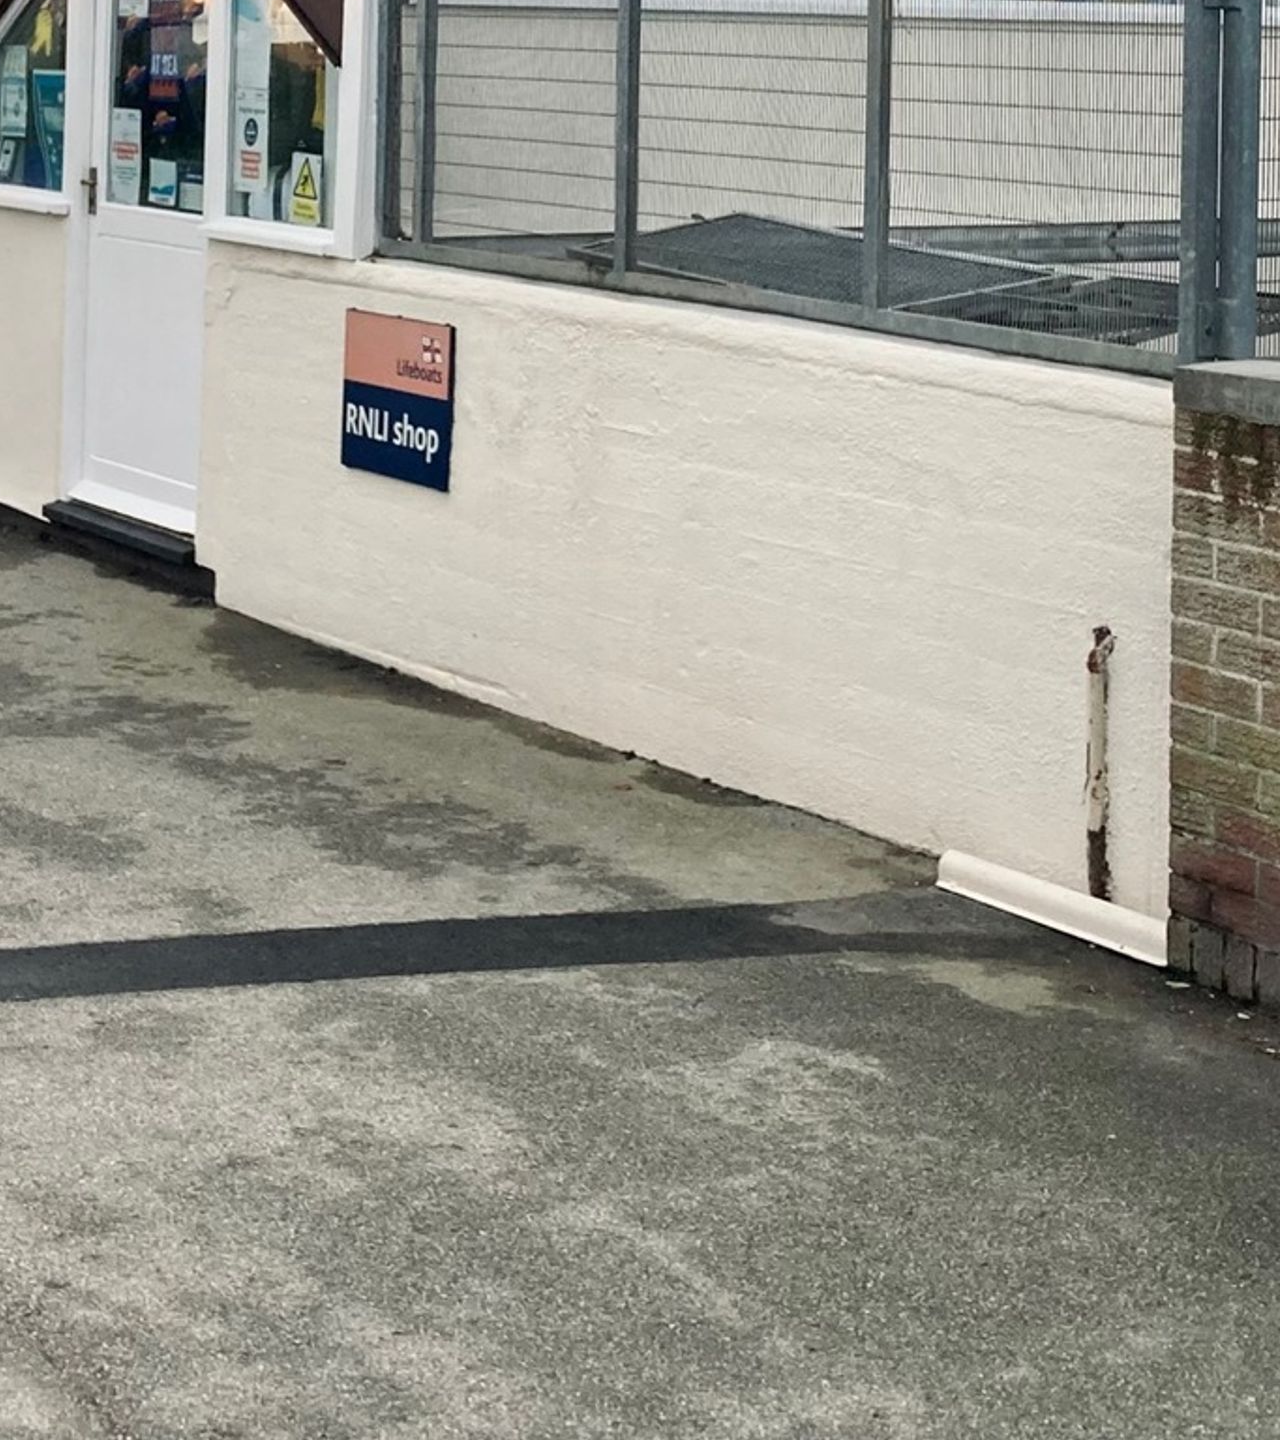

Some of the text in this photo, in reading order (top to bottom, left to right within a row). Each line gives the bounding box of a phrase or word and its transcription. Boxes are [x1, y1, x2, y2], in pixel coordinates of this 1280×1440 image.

[397, 360, 442, 384] Lifeboats
[346, 403, 440, 464] RNLI shop
